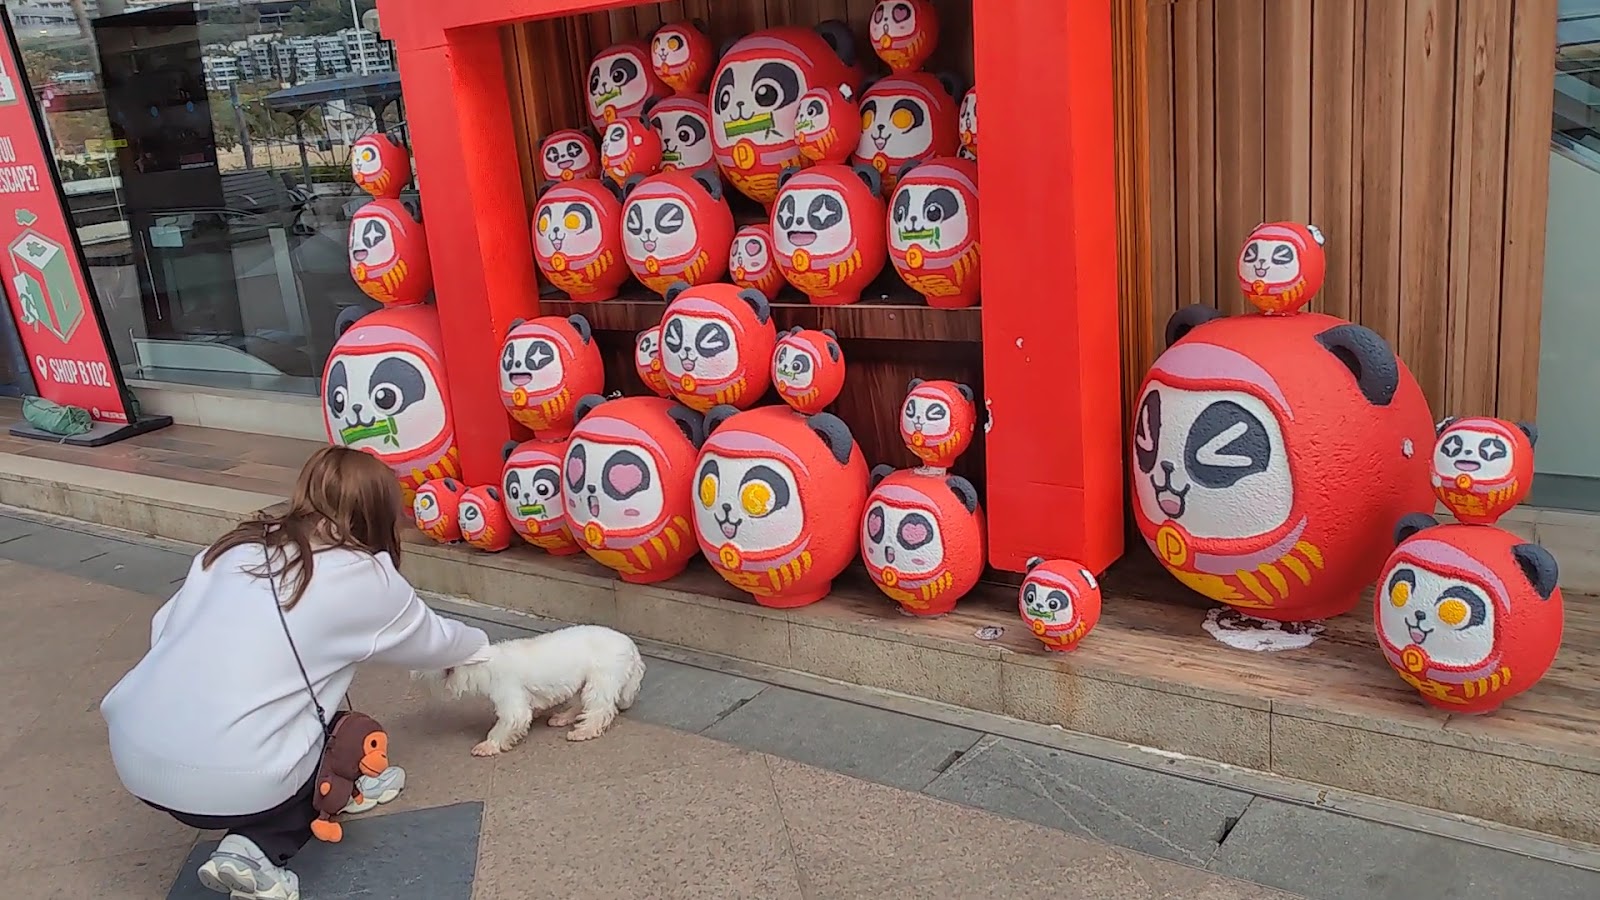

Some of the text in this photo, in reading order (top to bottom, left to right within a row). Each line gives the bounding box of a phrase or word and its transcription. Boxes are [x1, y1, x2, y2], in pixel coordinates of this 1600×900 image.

[0, 136, 16, 163] OU
[737, 145, 748, 167] P
[910, 252, 916, 264] P
[49, 357, 111, 387] SHOP B102
[515, 392, 521, 402] P
[1165, 531, 1182, 561] P
[725, 551, 734, 567] P
